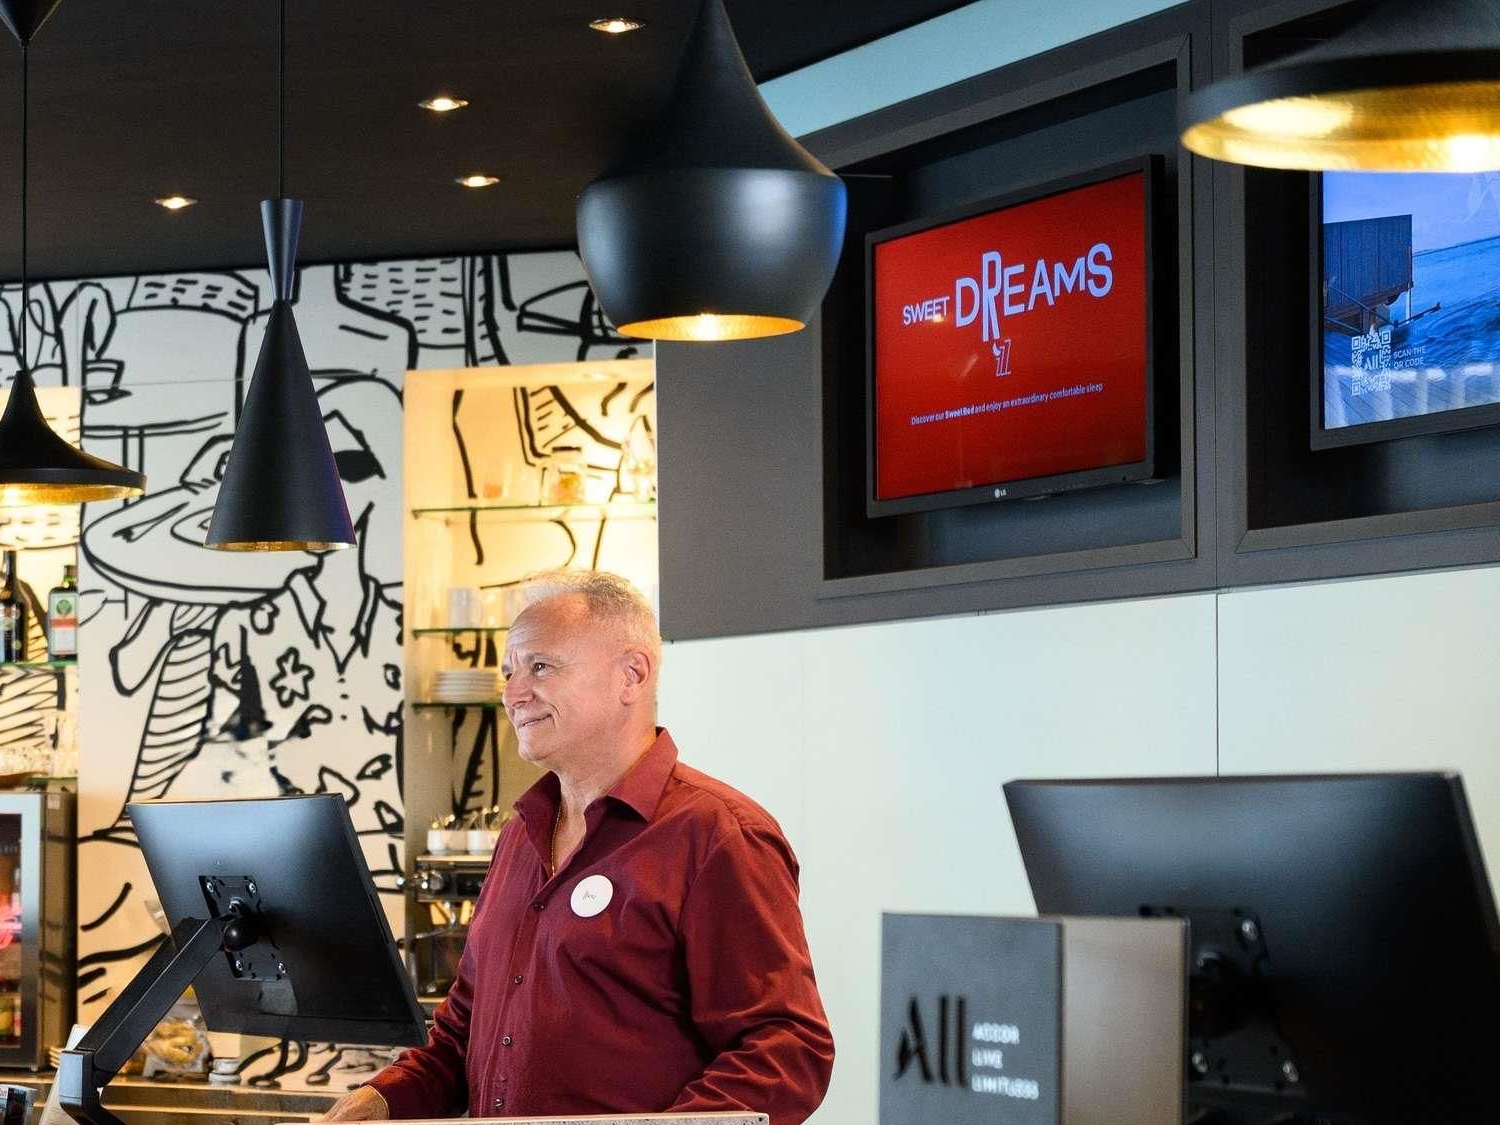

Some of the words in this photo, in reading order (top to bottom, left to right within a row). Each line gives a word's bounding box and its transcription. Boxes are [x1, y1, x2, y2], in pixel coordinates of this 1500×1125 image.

[902, 296, 950, 326] SWEET
[955, 242, 1113, 342] DREAMS
[1393, 348, 1412, 359] SCAN
[1413, 345, 1427, 355] THE
[1405, 357, 1425, 367] CODE
[893, 994, 968, 1088] All
[971, 1047, 1004, 1069] LIVE
